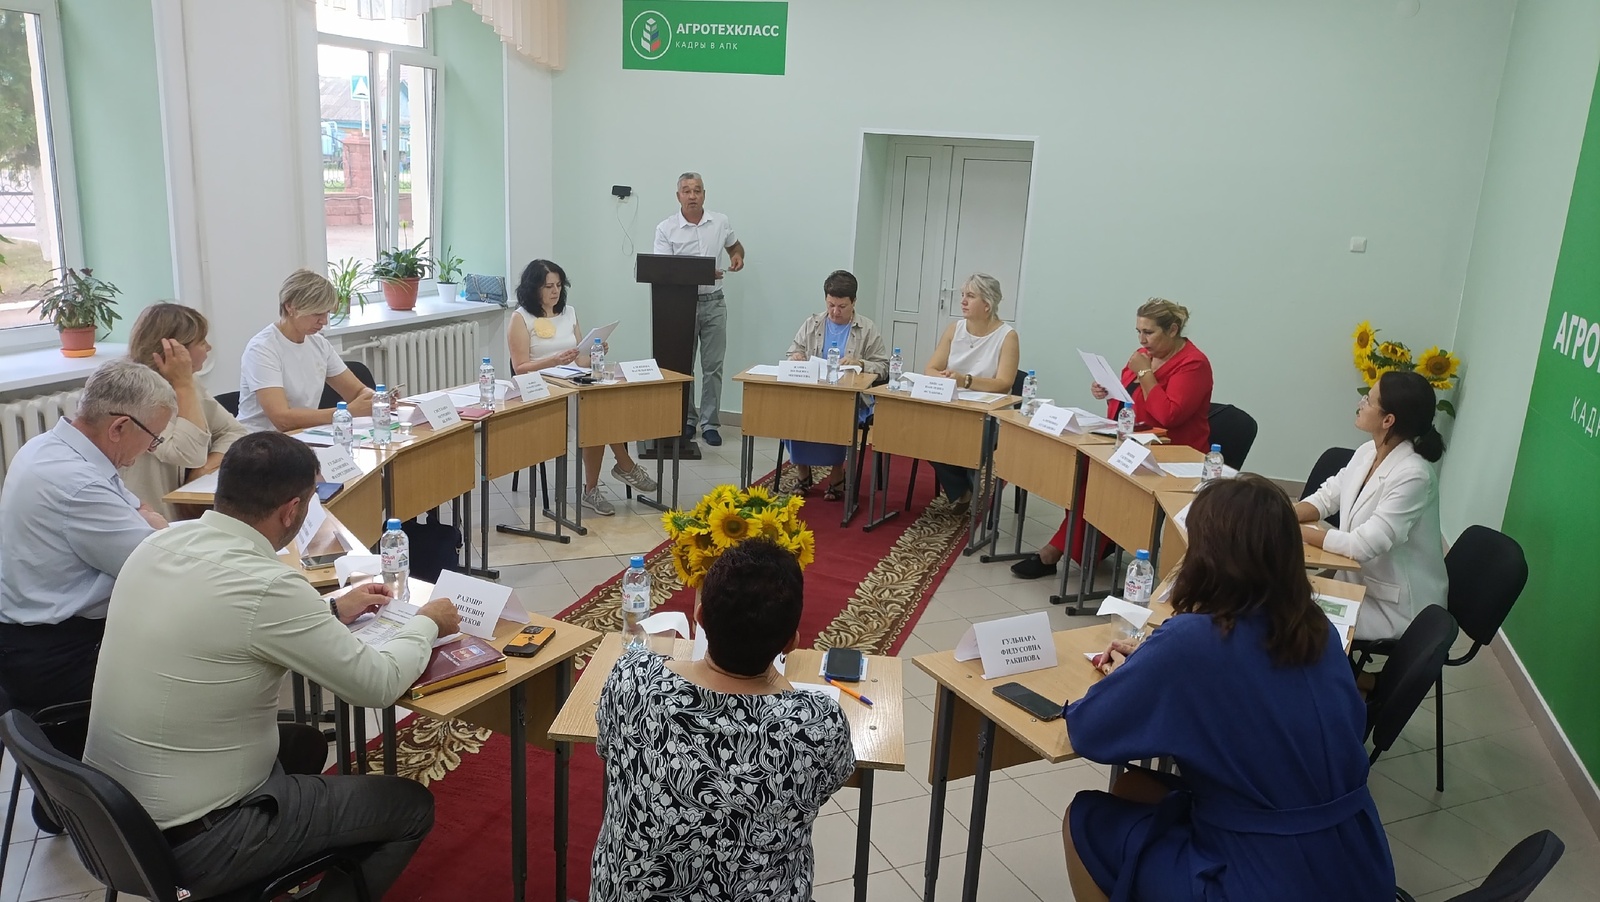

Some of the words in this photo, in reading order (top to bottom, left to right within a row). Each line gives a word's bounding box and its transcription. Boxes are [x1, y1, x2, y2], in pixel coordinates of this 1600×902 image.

[676, 23, 780, 37] АГРОТЕХКЛАСС
[675, 41, 706, 49] КАДРЫ
[719, 42, 738, 50] АПК
[1552, 311, 1600, 374] АГРО
[456, 593, 483, 606] РАДМИР
[455, 603, 485, 618] МИЛЕВИЧ
[461, 616, 481, 627] БЕКОВ
[1001, 635, 1037, 646] ГУЛЬНАРА
[1000, 644, 1042, 656] ФИДУСОВНА
